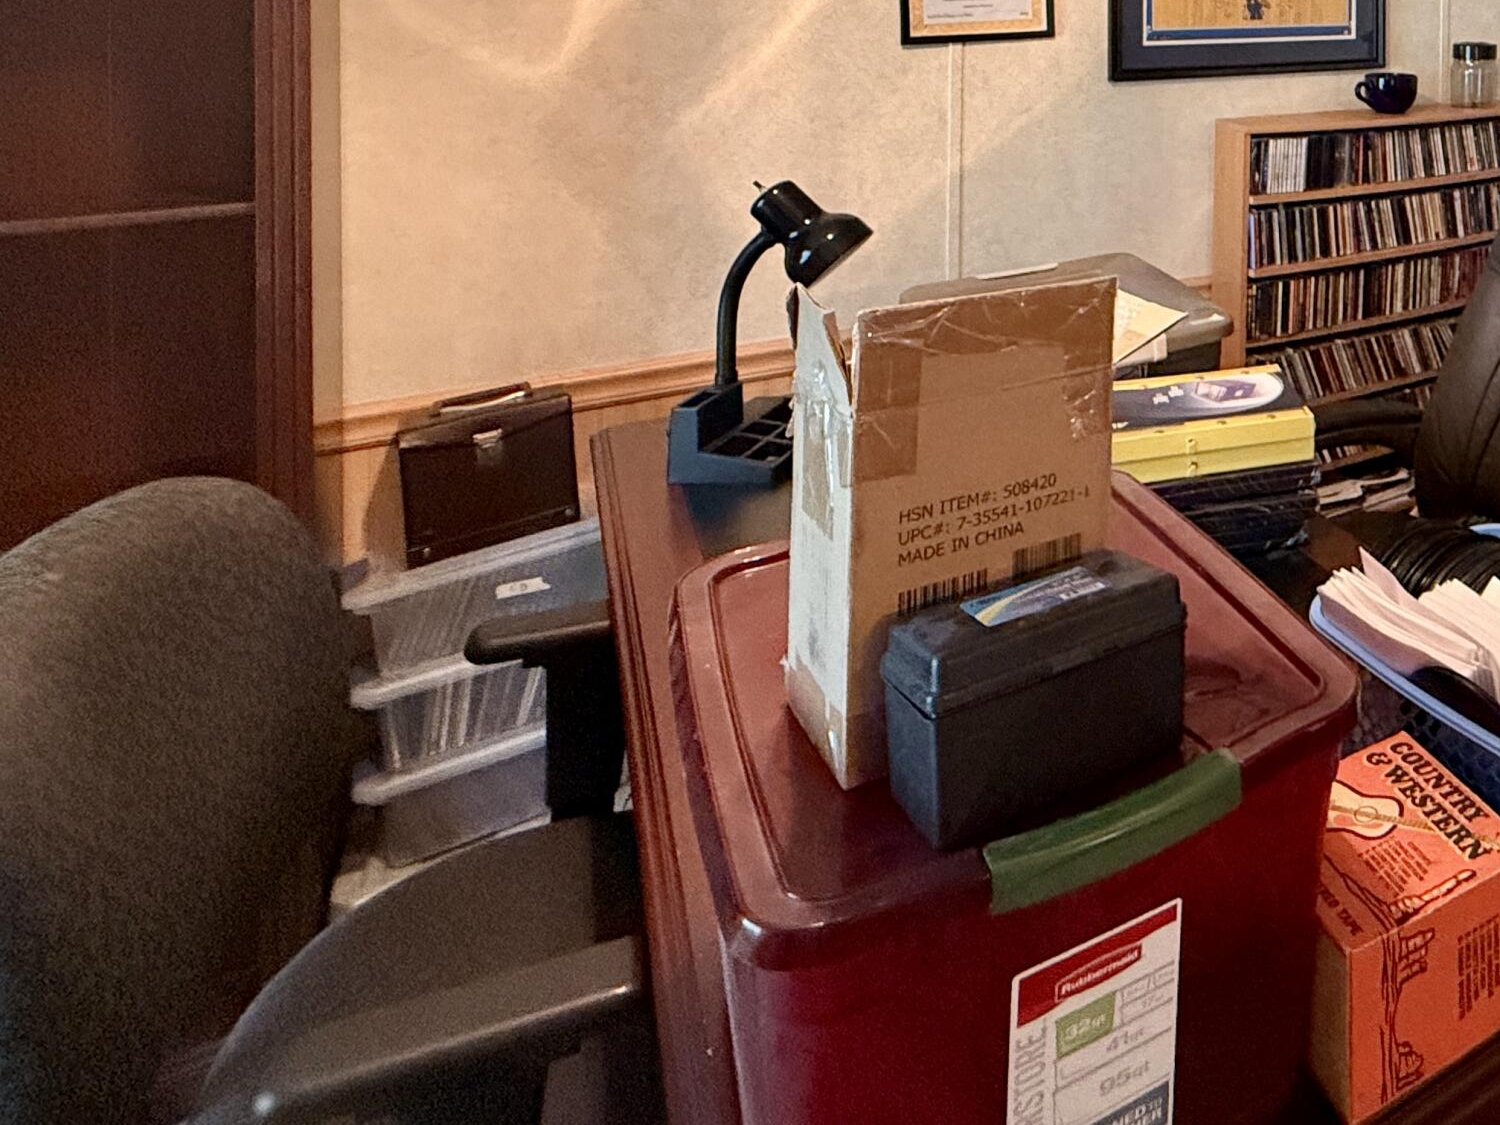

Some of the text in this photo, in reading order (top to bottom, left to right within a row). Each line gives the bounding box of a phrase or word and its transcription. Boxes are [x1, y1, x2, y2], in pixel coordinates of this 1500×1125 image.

[898, 485, 1090, 546] UPC#: 7-35541-107221-1
[899, 473, 1057, 524] HSN ITEM#: 508420
[898, 521, 1025, 567] MADE IN CHINA
[1366, 752, 1493, 859] & WESTERN
[1389, 742, 1490, 823] COUNTRY
[1061, 949, 1138, 995] Rubbermaid
